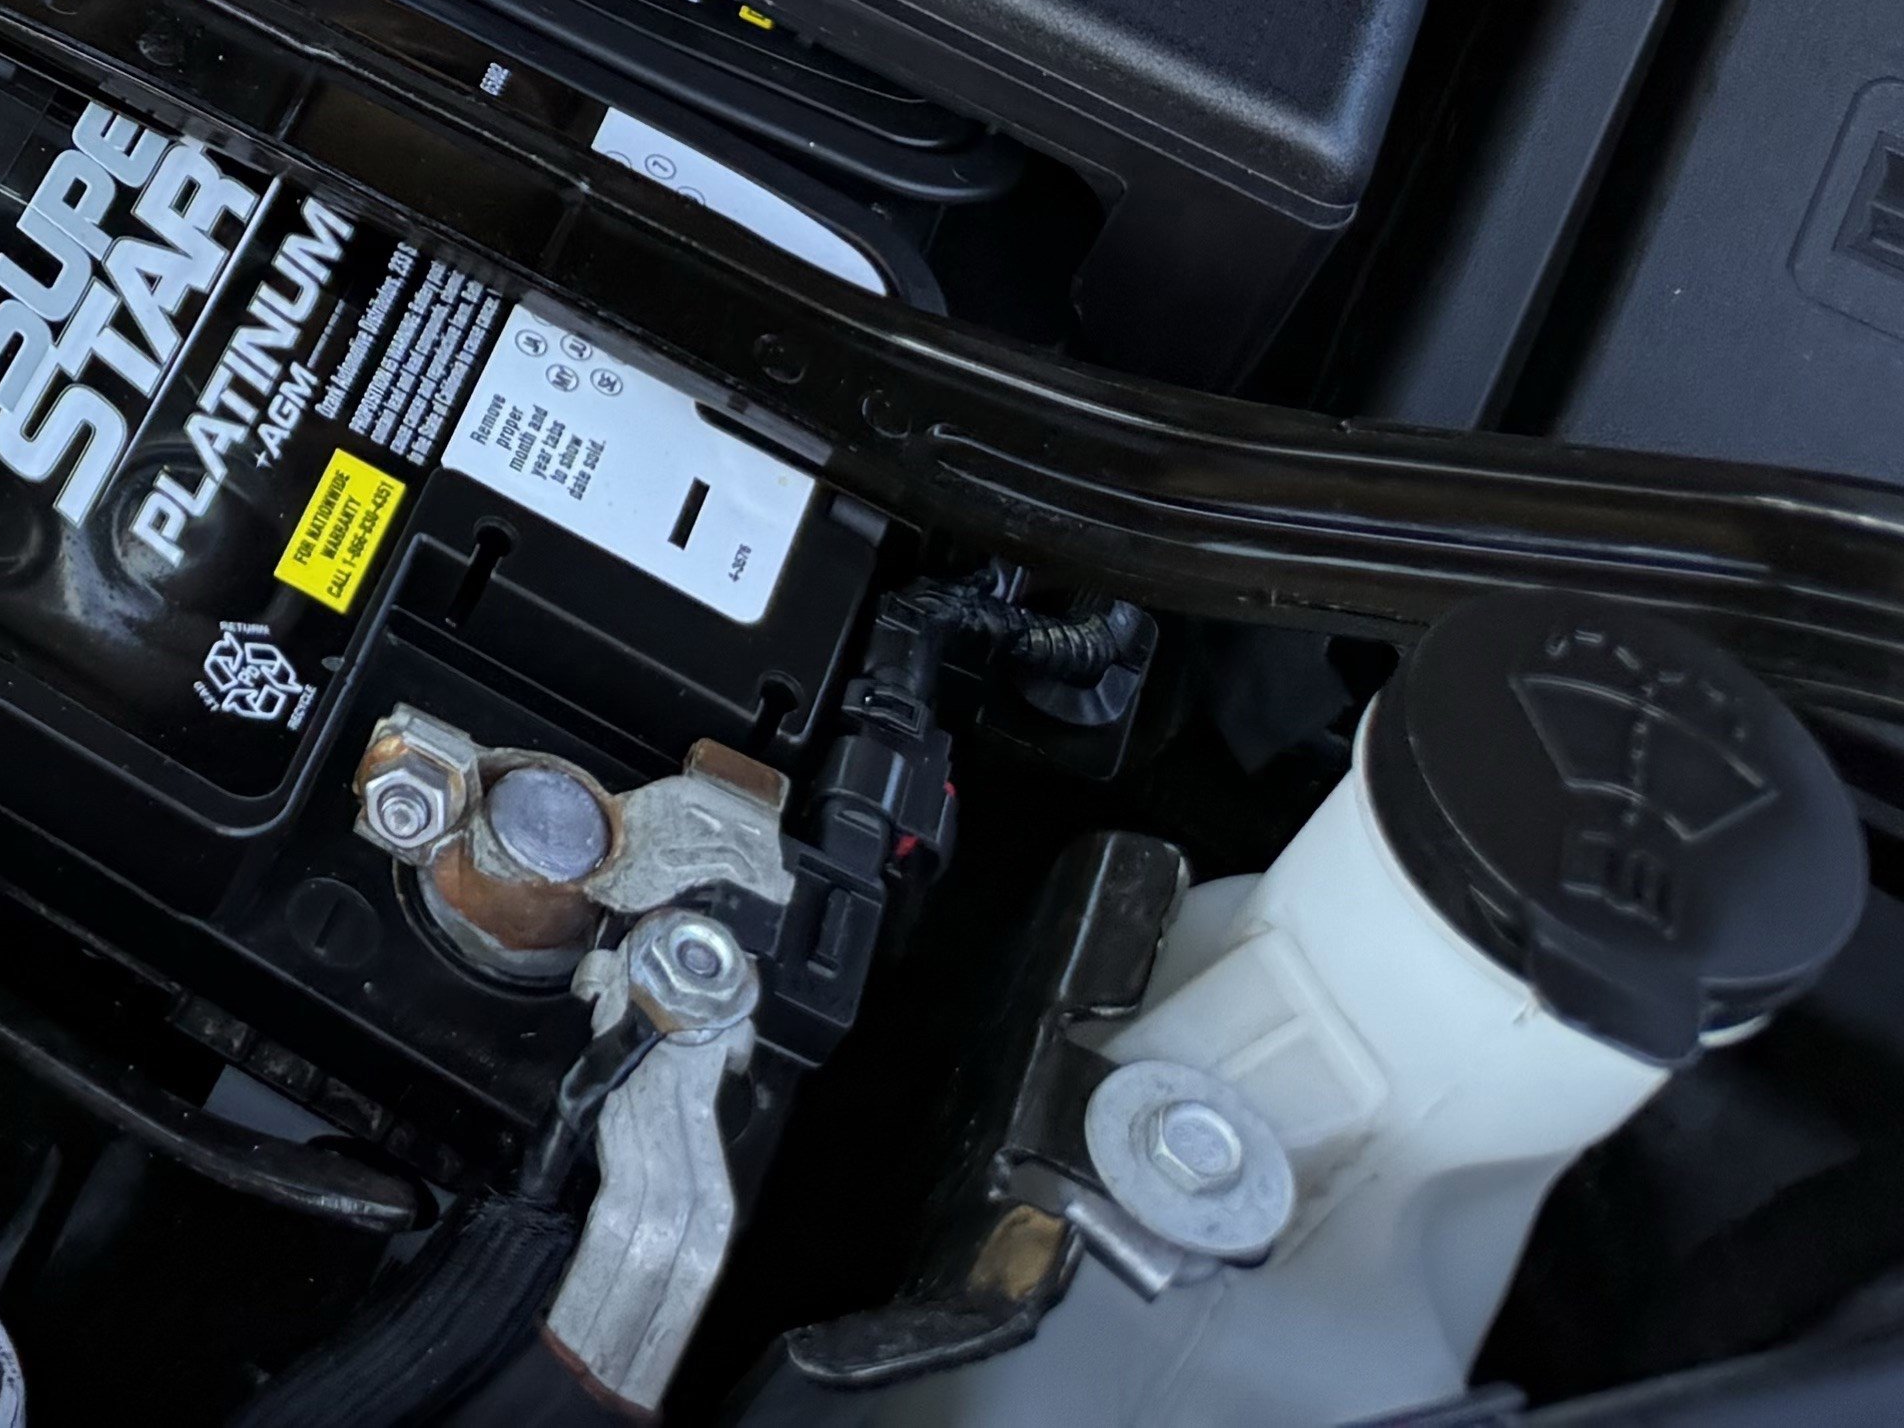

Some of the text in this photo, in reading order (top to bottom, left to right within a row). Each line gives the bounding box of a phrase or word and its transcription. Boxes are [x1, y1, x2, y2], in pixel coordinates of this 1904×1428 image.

[128, 196, 356, 569] PLATINUM
[256, 361, 319, 460] AGM
[314, 384, 347, 420] Ozark
[348, 367, 393, 435] PROPOSITION
[469, 393, 507, 446] Remove
[495, 405, 524, 451] proper
[508, 404, 549, 473] month and
[530, 419, 566, 481] year tabs
[549, 434, 583, 485] to show
[566, 438, 607, 501] date sold.
[292, 469, 351, 566] FOR NATIONWIDE
[320, 494, 361, 560] WARRANTY
[326, 568, 352, 600] CALL
[219, 618, 270, 635] RETURN
